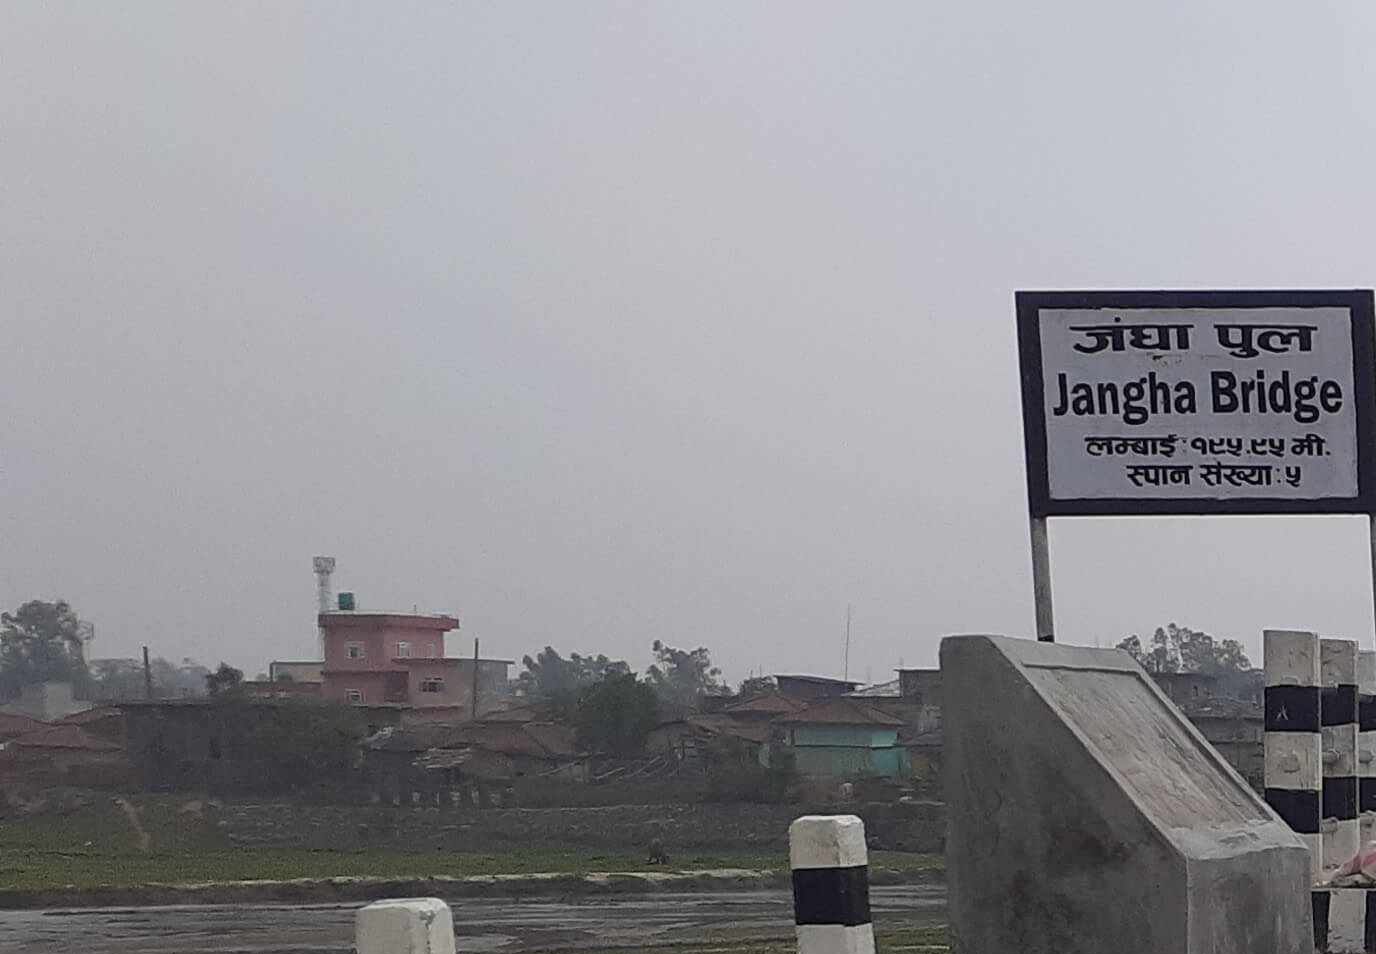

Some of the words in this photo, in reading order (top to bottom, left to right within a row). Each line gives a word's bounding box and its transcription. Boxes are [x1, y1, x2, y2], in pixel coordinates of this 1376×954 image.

[1069, 317, 1195, 354] जंघा
[1214, 324, 1319, 358] पुल
[1052, 372, 1197, 425] Jangha
[1210, 369, 1343, 423] Bridge
[1126, 465, 1194, 487] स्पान
[1285, 465, 1302, 488] ५
